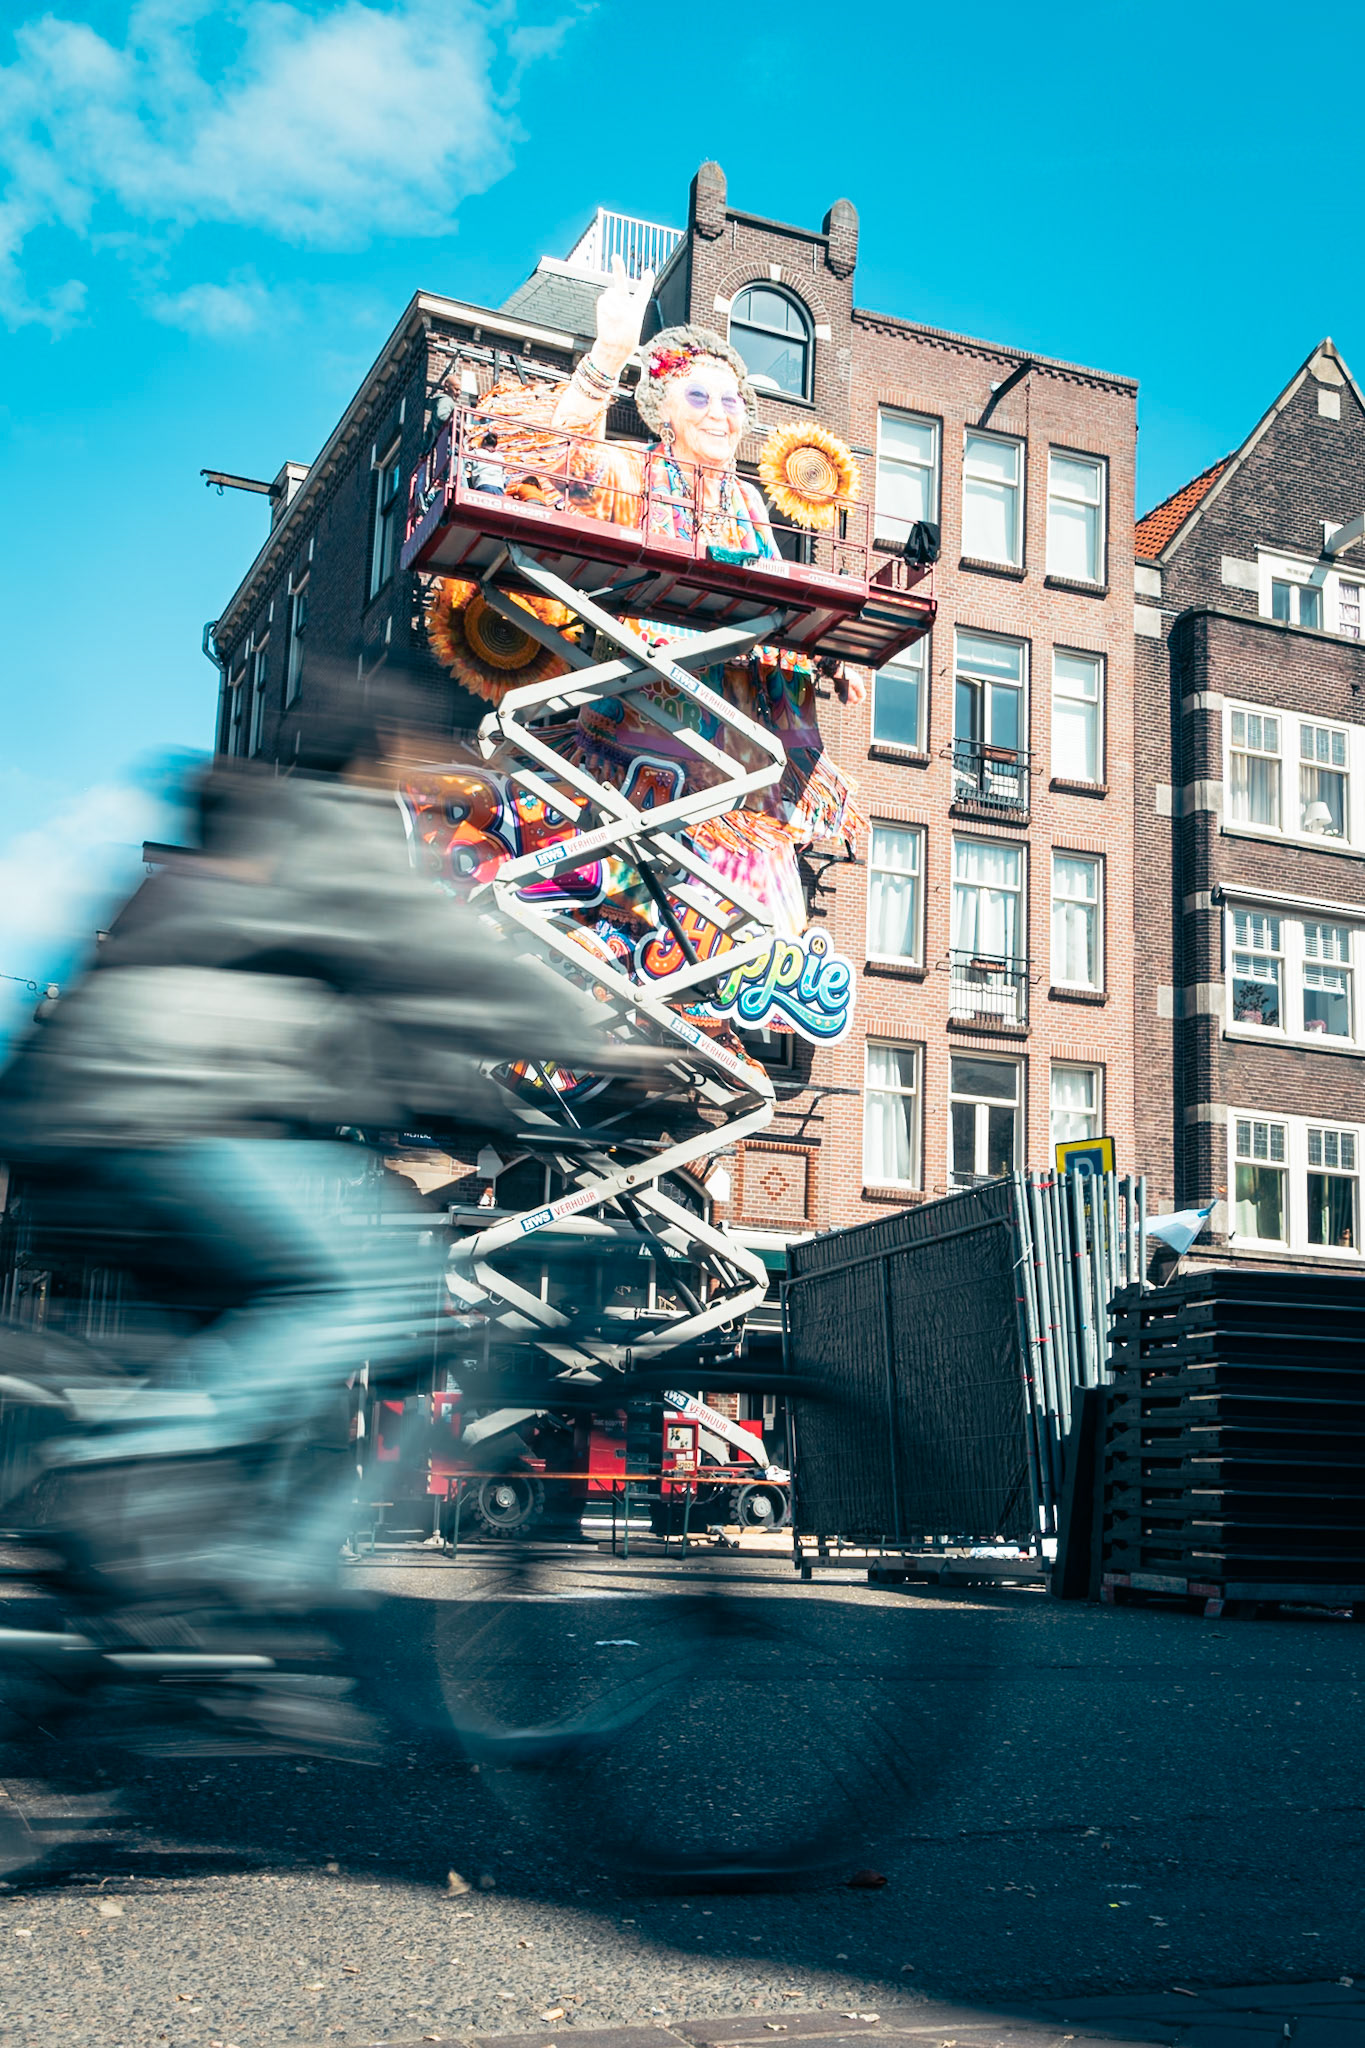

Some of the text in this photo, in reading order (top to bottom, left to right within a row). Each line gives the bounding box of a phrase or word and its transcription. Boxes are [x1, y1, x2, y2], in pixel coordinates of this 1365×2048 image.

[671, 666, 699, 692] HWS
[700, 688, 737, 720] VERHUUR
[536, 832, 608, 866] HWS VERHUUR
[671, 1018, 739, 1071] HWS VERHUUR
[522, 1191, 597, 1232] HWS VERHUUR
[689, 1402, 729, 1433] VERHUUR
